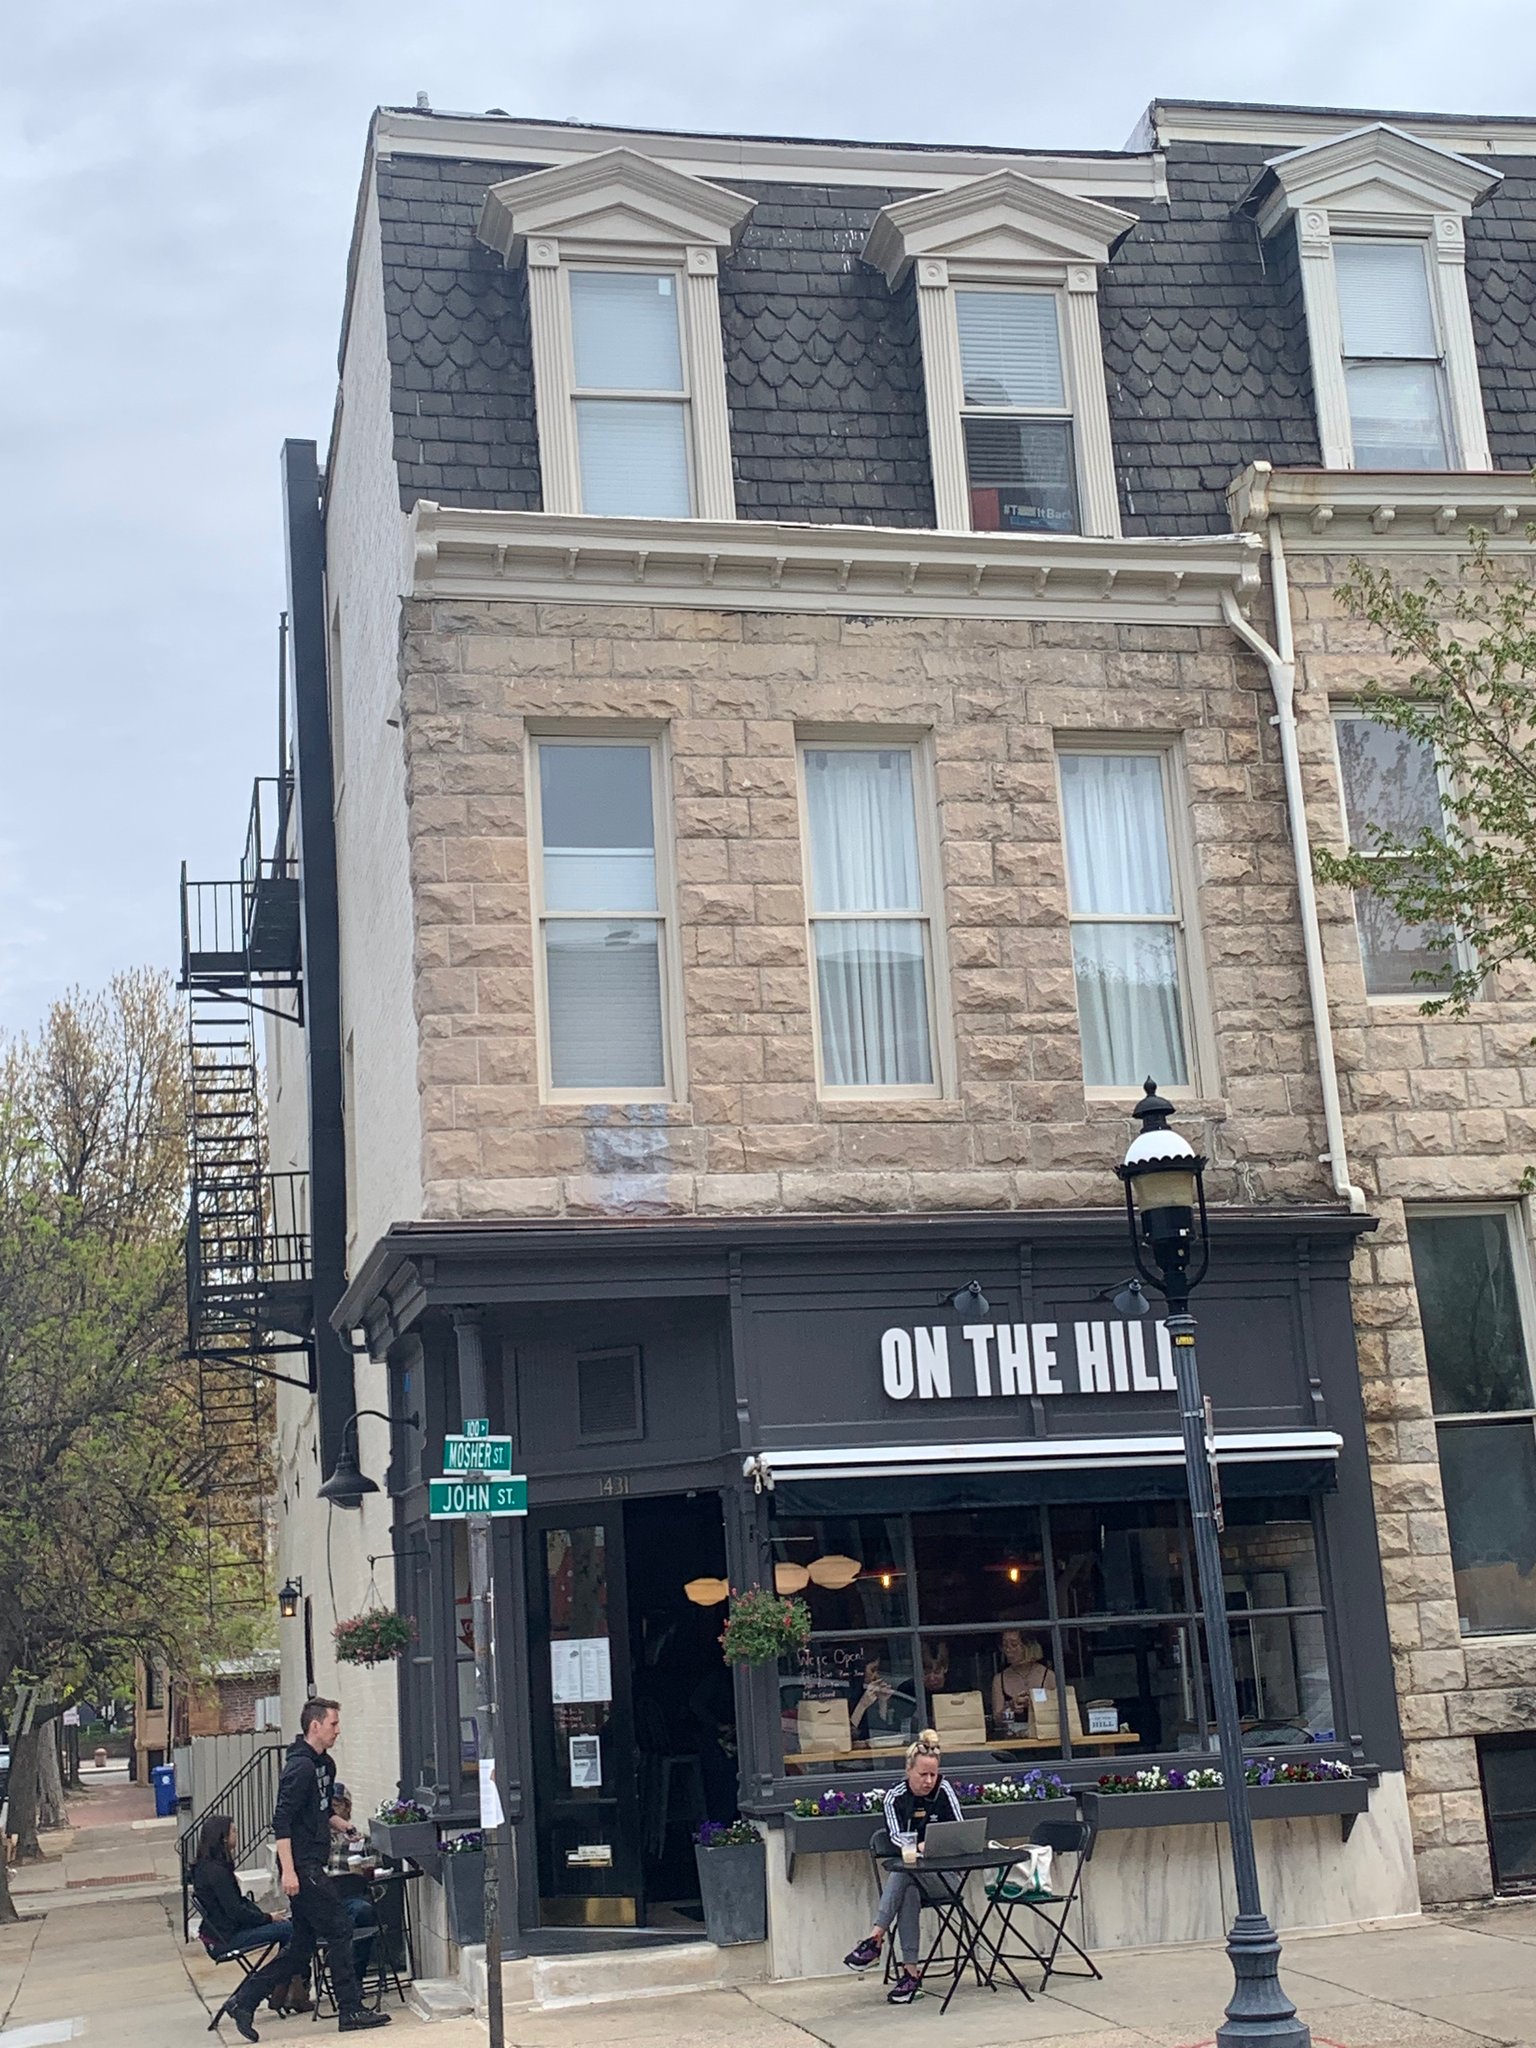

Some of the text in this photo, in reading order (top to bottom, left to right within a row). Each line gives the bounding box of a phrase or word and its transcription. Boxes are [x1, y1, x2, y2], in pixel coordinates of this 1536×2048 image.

[880, 1320, 1178, 1401] ON THE HILL
[449, 1442, 491, 1468] MOSHER
[443, 1484, 515, 1512] JOHN ST.
